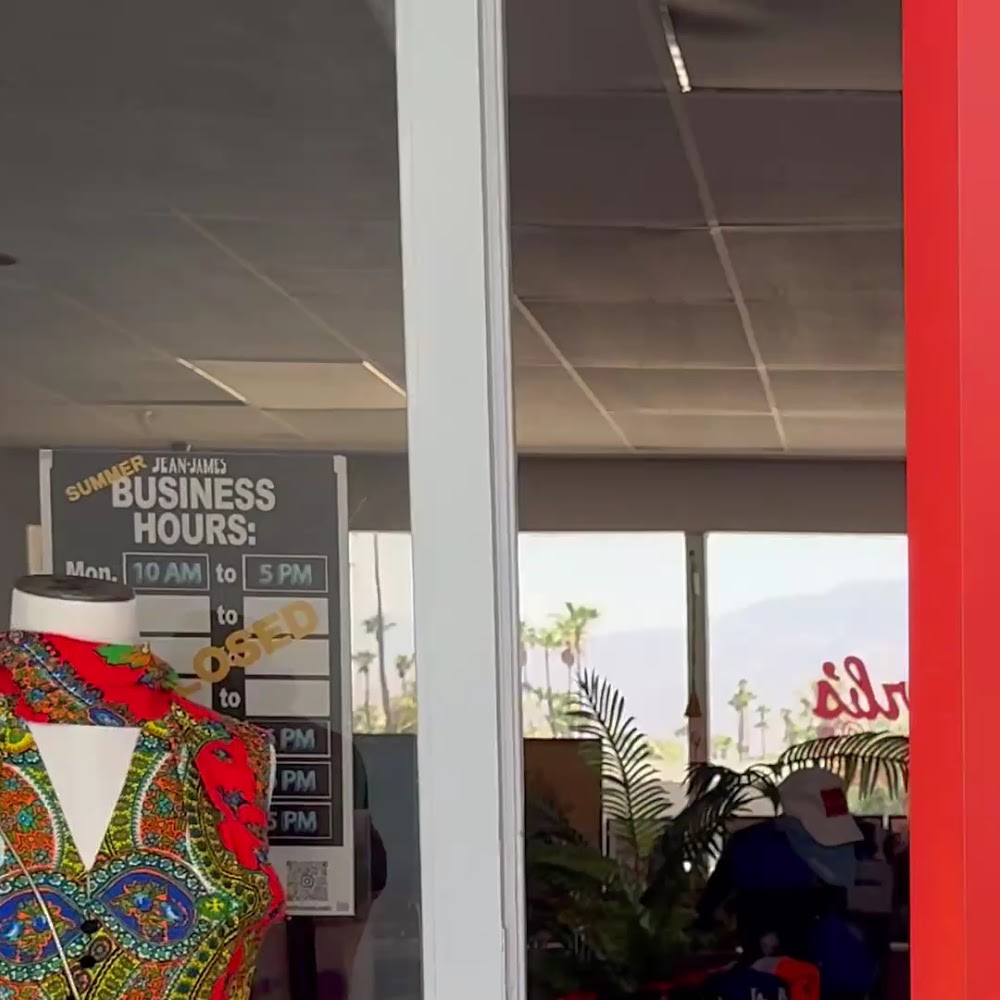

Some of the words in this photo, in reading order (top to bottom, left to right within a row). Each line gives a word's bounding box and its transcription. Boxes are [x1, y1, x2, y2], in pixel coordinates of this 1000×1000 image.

[65, 455, 147, 502] SUMMER
[111, 476, 276, 511] BUSINESS
[134, 512, 256, 545] HOURS:
[66, 561, 117, 583] Mon.
[133, 562, 159, 584] 10
[162, 562, 202, 584] AM
[215, 564, 237, 583] to
[258, 564, 272, 584] 5
[276, 564, 312, 585] PM
[217, 605, 238, 625] to
[174, 601, 318, 697] OSED
[219, 688, 241, 708] to
[280, 728, 316, 749] PM
[281, 770, 317, 792] PM
[283, 811, 318, 832] PM
